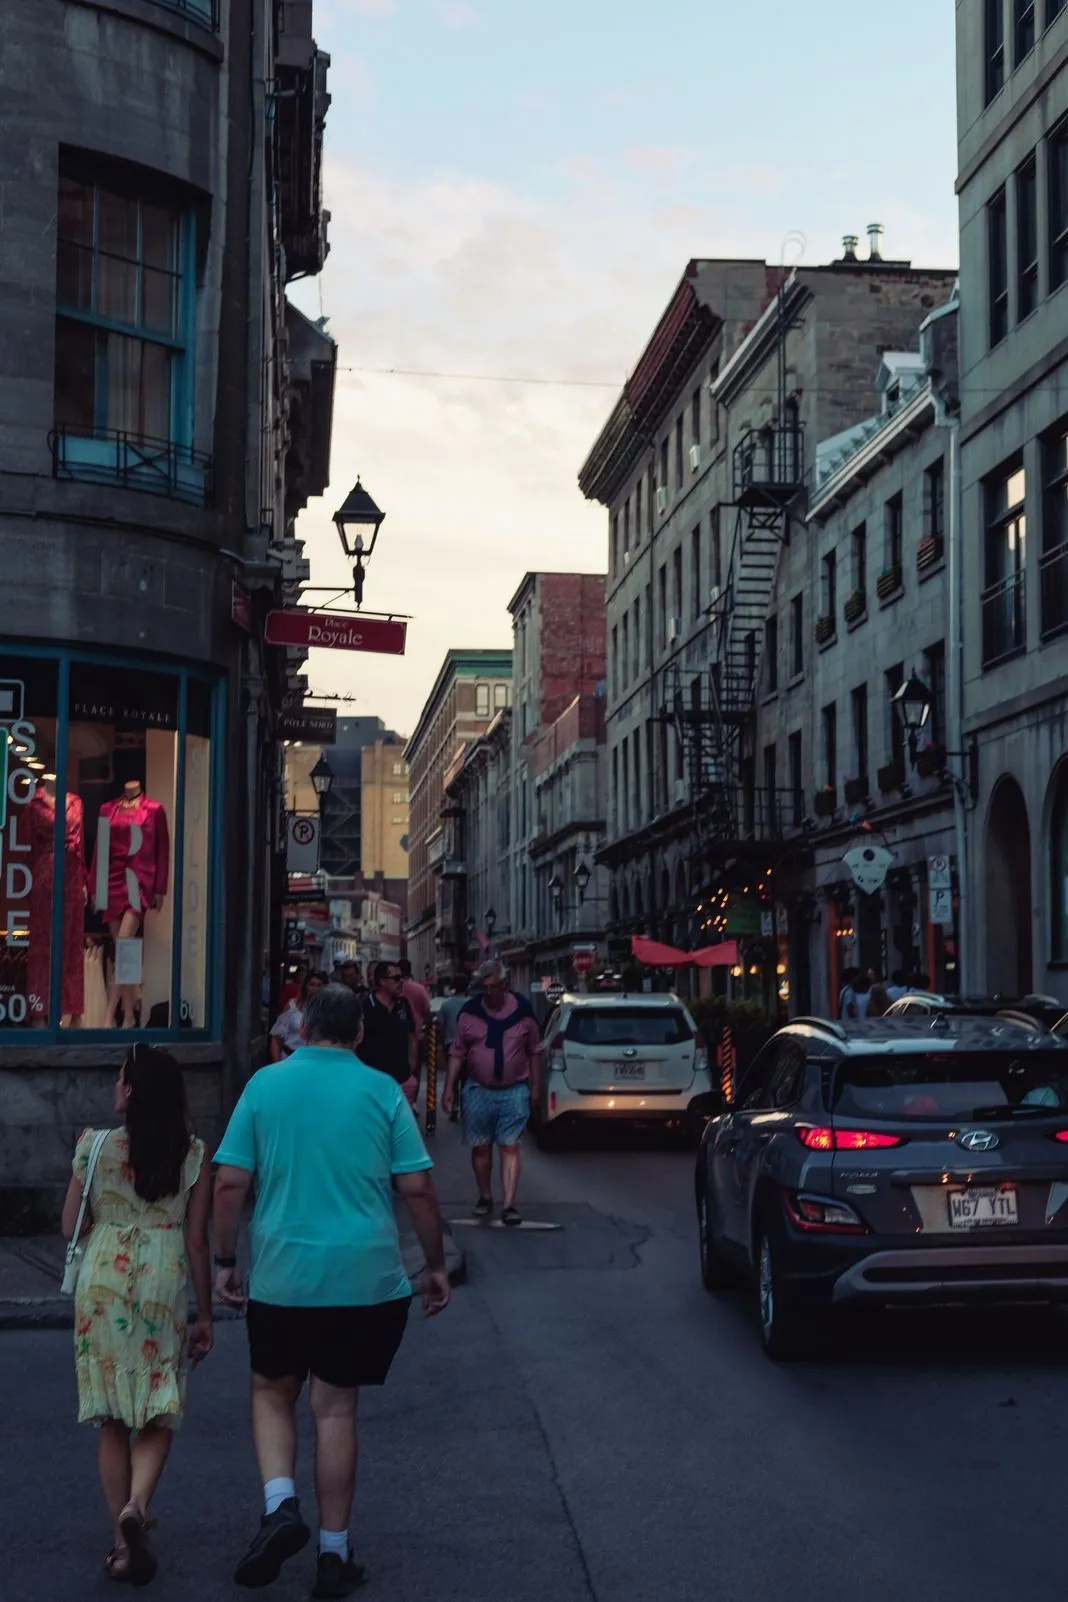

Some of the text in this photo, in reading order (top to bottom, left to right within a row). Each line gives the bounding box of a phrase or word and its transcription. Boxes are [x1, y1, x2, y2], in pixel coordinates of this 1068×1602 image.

[307, 625, 363, 648] Royale
[74, 703, 171, 723] PLACE ROYALE
[6, 720, 36, 947] SOLDE
[989, 1197, 1016, 1215] YTL
